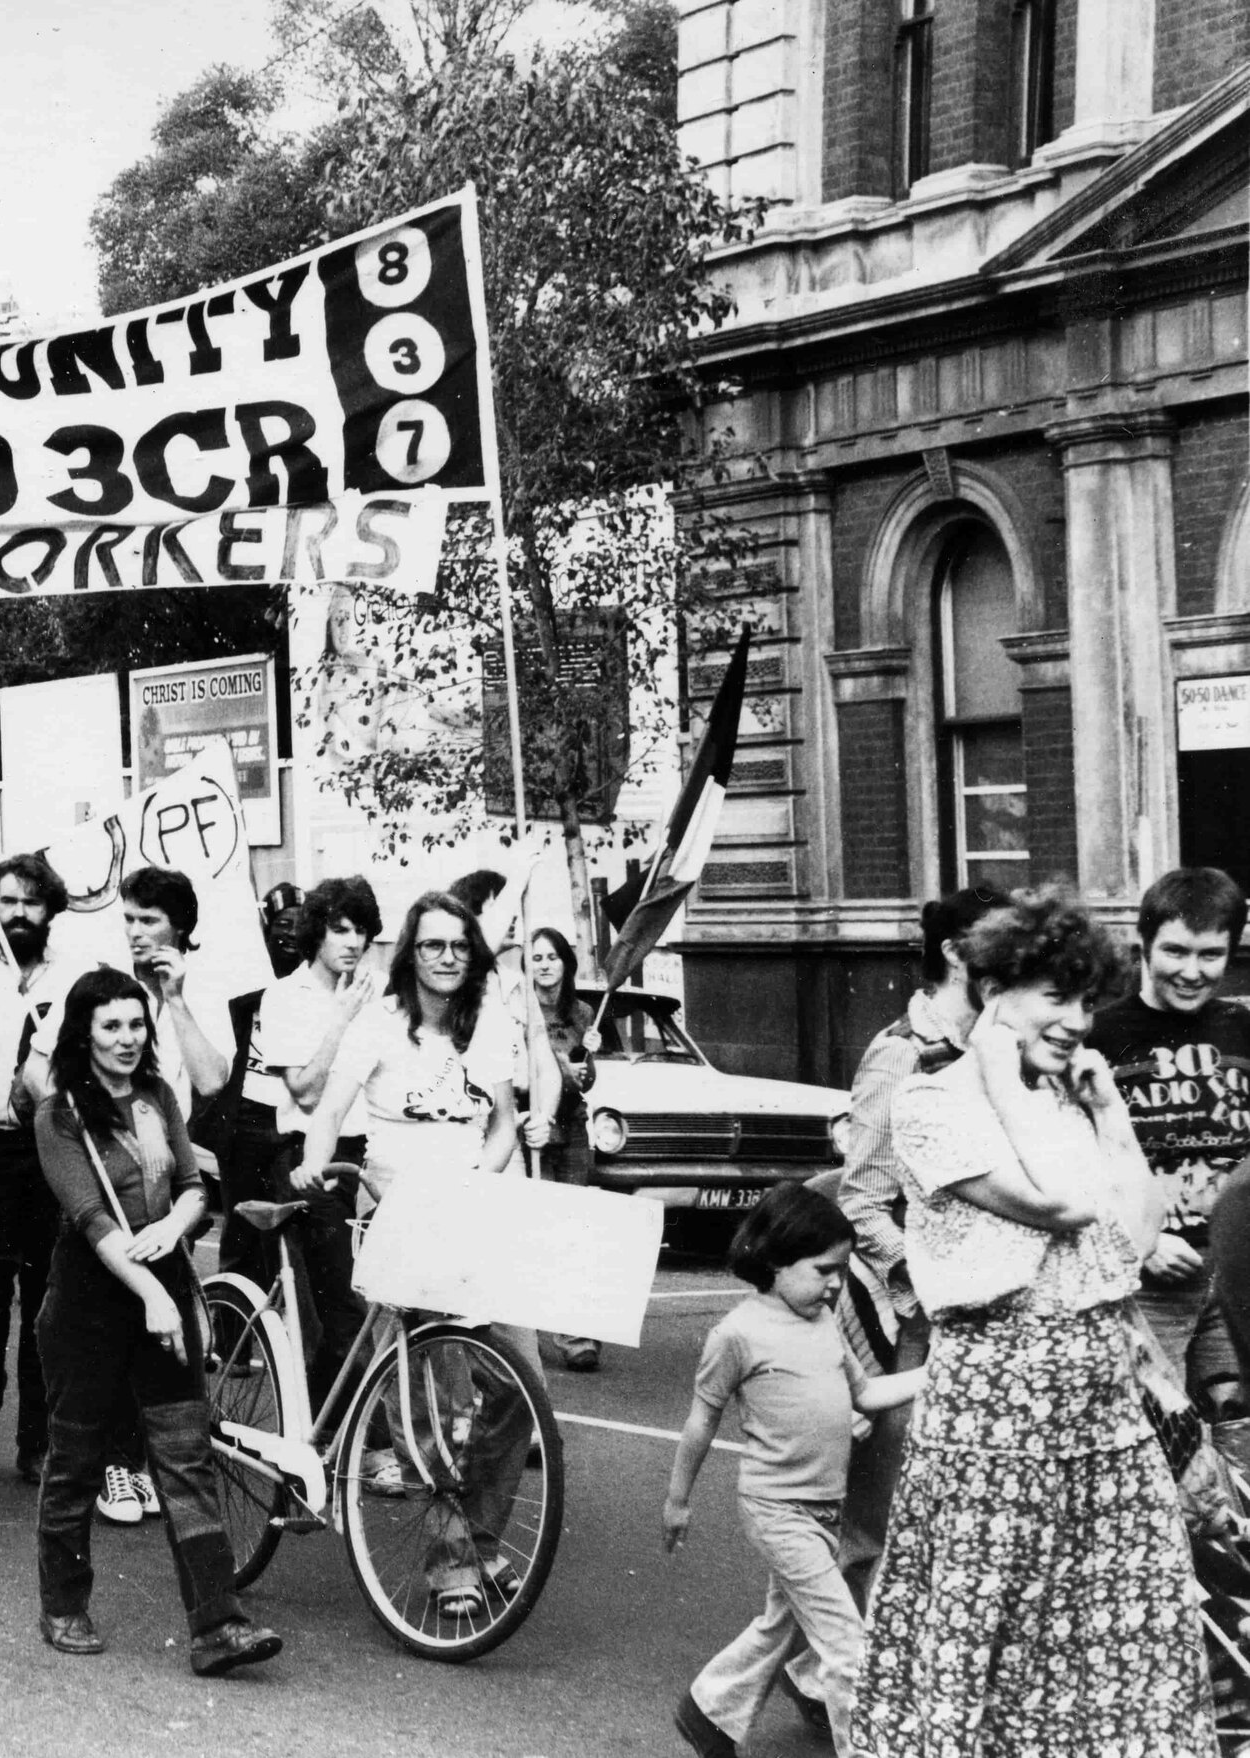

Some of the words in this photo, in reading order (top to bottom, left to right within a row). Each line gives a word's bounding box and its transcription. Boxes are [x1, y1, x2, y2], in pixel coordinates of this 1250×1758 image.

[42, 400, 329, 516] 3CR
[142, 681, 187, 706] CHRIST
[190, 679, 206, 700] IS
[209, 672, 262, 698] COMING
